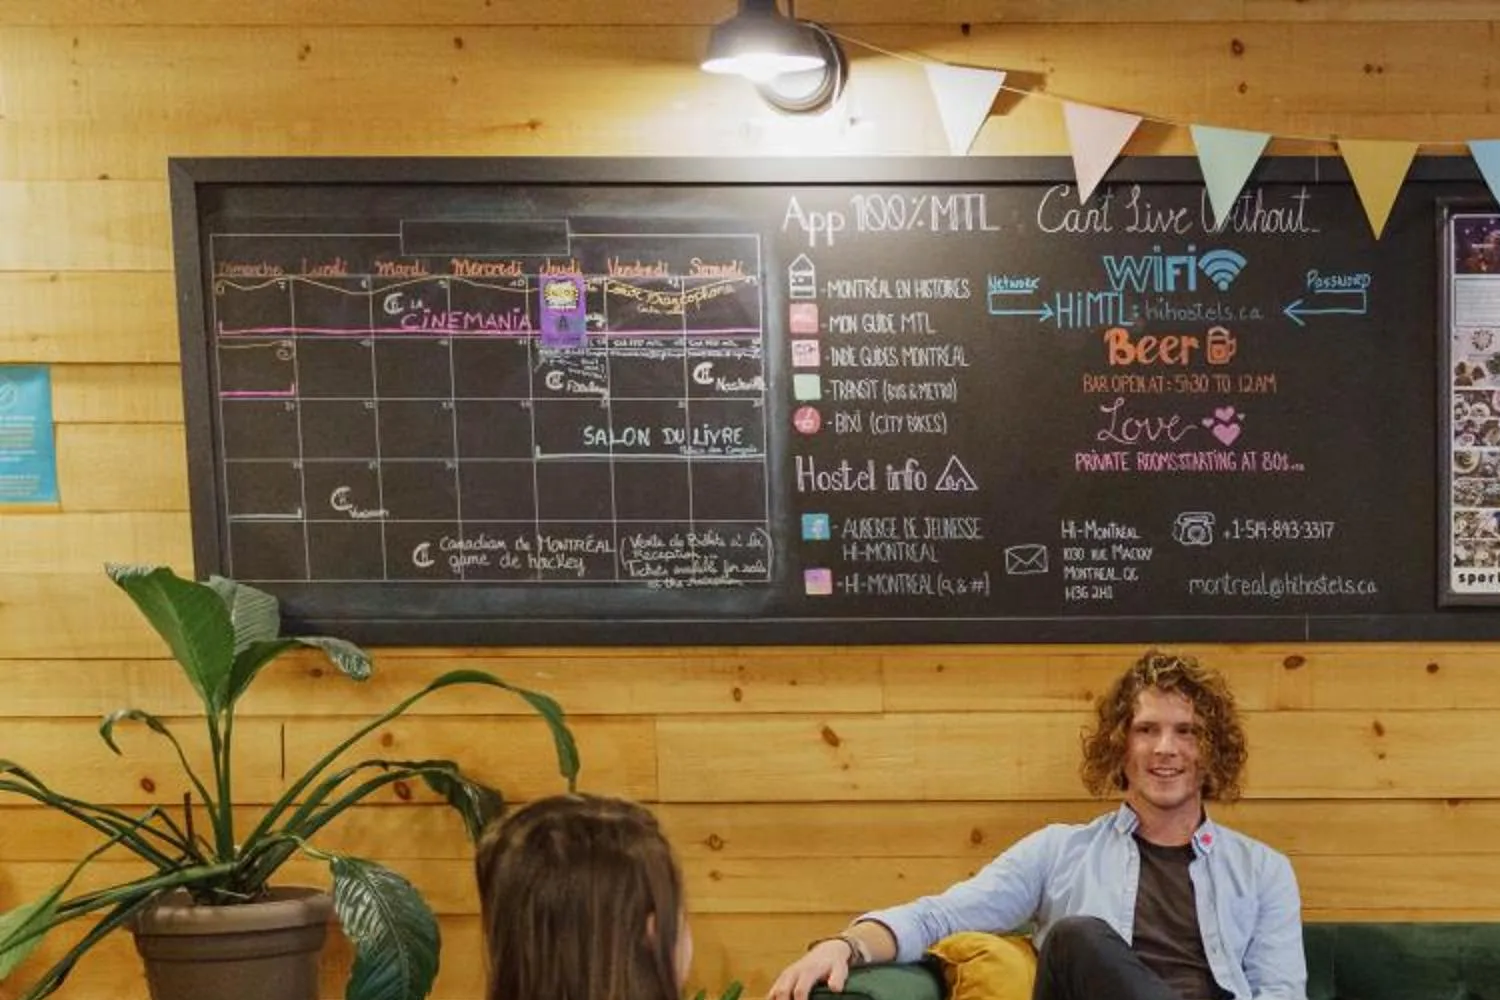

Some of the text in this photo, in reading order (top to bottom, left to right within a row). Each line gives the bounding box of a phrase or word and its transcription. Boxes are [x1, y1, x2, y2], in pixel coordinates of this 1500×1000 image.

[783, 196, 845, 247] App
[930, 193, 1000, 232] MTL
[1125, 184, 1193, 234] Live
[901, 312, 936, 334] MTL
[1146, 297, 1264, 321] hihostels.ca
[1104, 328, 1200, 366] Beer
[1083, 373, 1110, 393] BAR
[1111, 374, 1146, 393] OPEN
[1213, 375, 1231, 393] TO
[1098, 397, 1198, 444] Love
[584, 426, 650, 446] SALON
[663, 427, 685, 445] DU
[795, 455, 927, 492] Hostel info
[1241, 451, 1258, 472] AT
